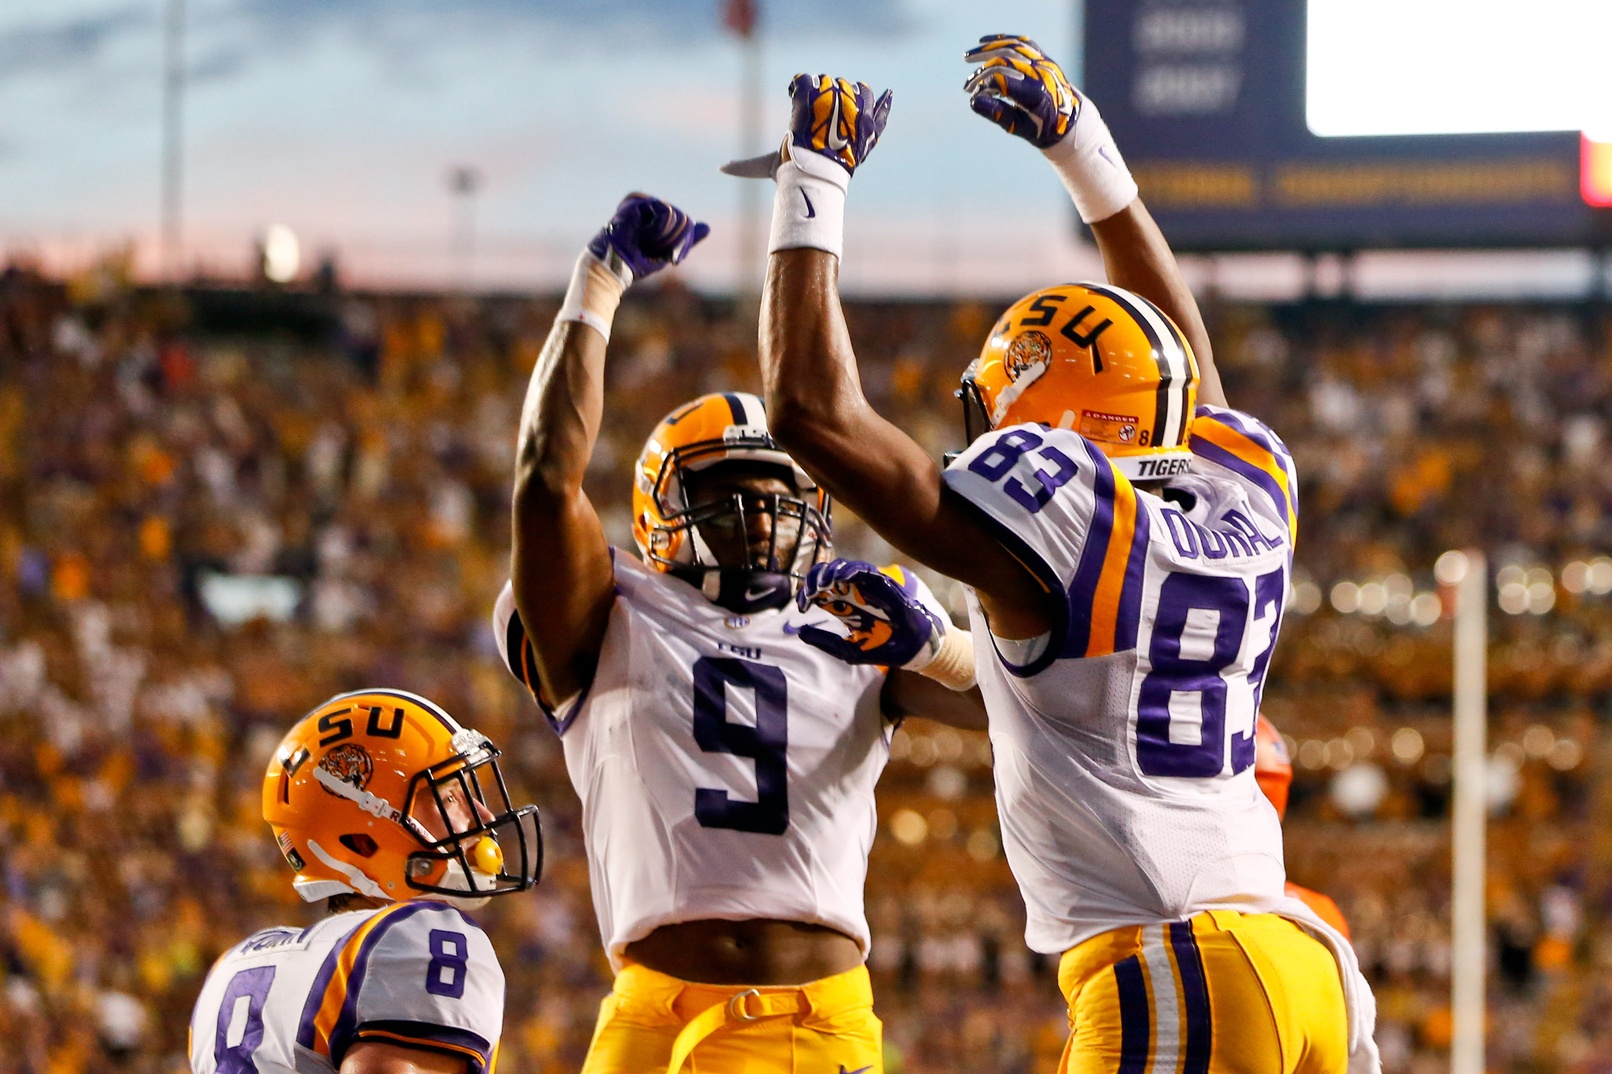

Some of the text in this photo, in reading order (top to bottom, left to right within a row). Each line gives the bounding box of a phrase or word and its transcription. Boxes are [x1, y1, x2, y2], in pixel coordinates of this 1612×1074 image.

[968, 428, 1080, 514] 83
[1138, 429, 1150, 447] 8
[1136, 565, 1284, 778] 83
[693, 656, 790, 836] 9
[425, 928, 469, 1000] 8
